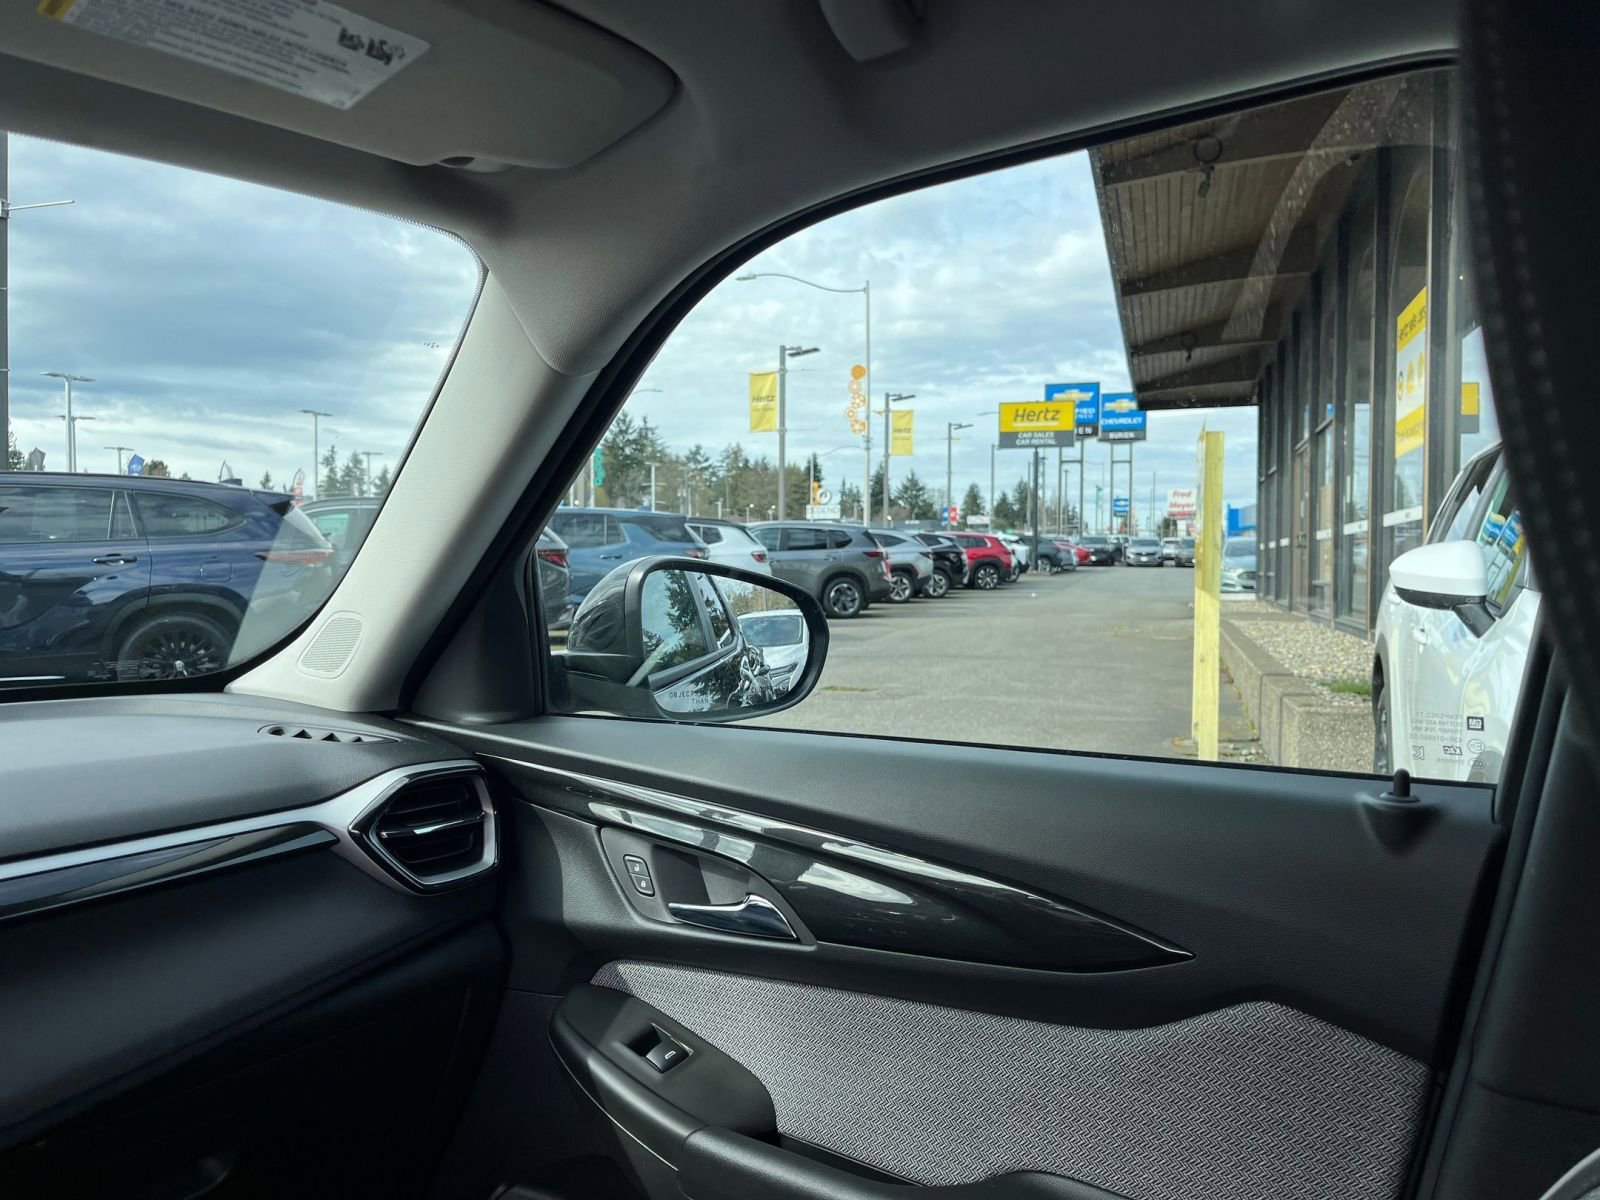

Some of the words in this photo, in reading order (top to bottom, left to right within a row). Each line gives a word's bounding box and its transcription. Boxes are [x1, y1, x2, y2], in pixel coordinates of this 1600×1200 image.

[752, 394, 776, 403] Hertz
[1013, 407, 1061, 422] Hertz
[1101, 417, 1142, 425] CHEVROLET
[1109, 431, 1135, 439] BURIEN
